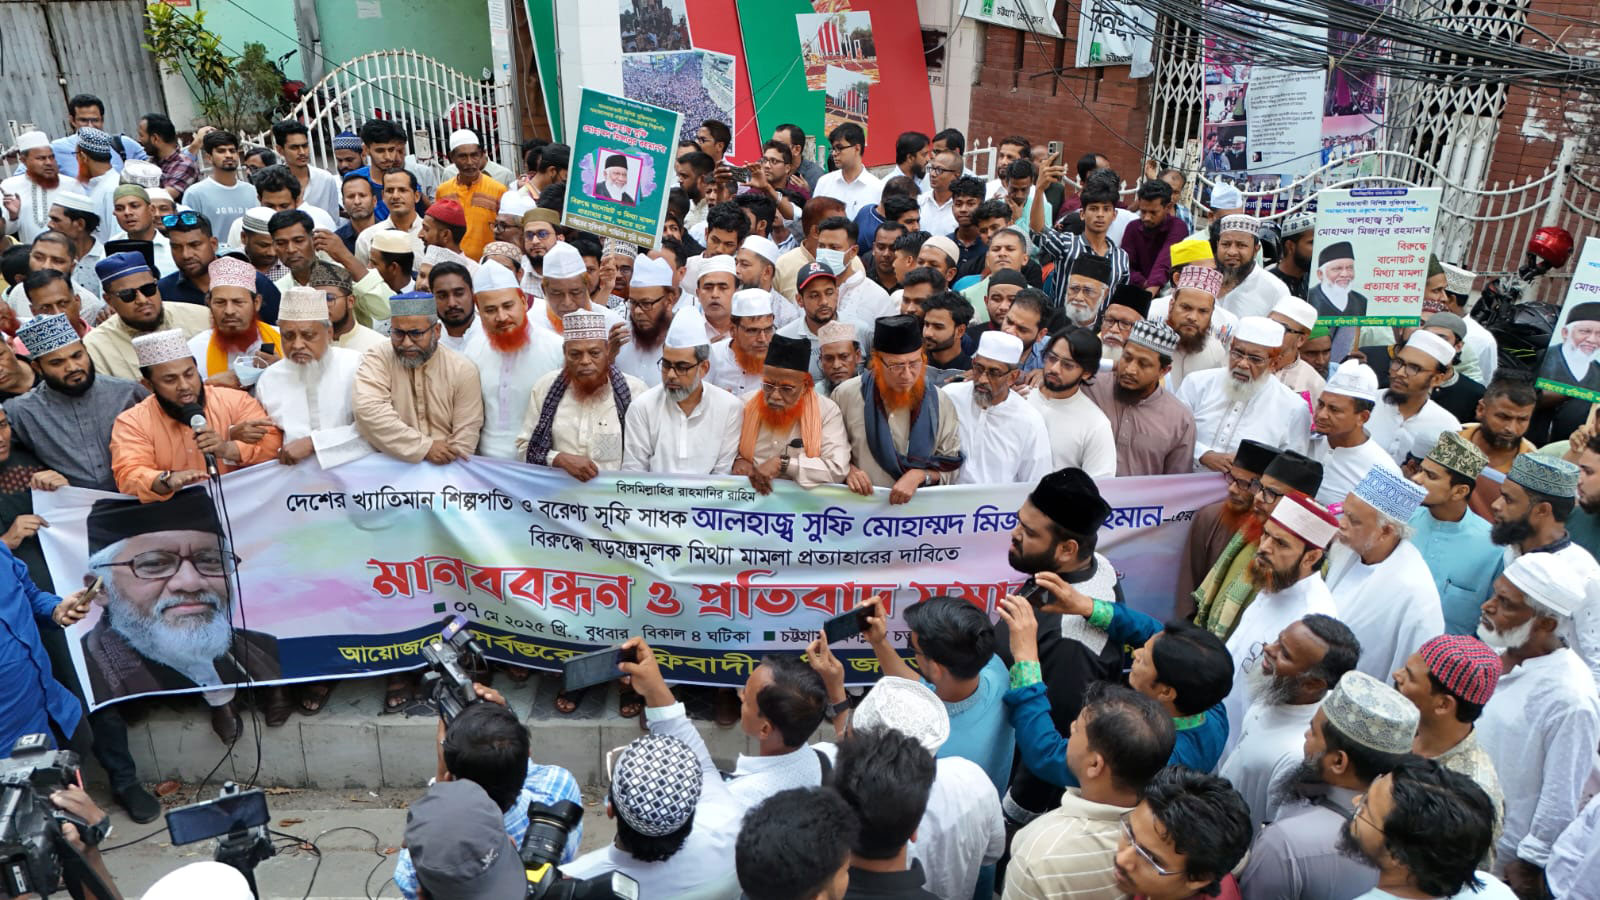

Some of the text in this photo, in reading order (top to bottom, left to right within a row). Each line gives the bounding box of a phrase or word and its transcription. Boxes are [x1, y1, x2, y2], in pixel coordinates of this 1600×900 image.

[1318, 228, 1354, 236] মোহাম্মদ
[1357, 226, 1390, 237] মিজানুর
[1397, 240, 1428, 251] বিরুদ্ধে
[1373, 267, 1425, 277] মিথ্যা মামলা
[616, 480, 756, 503] বিসমিল্লাহির রাহমানির রাহিম
[286, 490, 347, 512] দেশের
[352, 485, 435, 512] খ্যাতিমান
[440, 484, 513, 512] শিল্পপতি
[520, 499, 533, 514] ও
[538, 500, 589, 523] বরেণ্য
[594, 501, 633, 531] সূফি
[638, 508, 688, 528] সাধক
[691, 506, 795, 543] আলহাজ্ব
[802, 506, 855, 544] সুফি
[863, 513, 966, 538] মোহাম্মদ
[528, 524, 962, 568] বিরুদ্ধে ষড়যন্ত্রমূলক মিথ্যা মামলা প্রত্যাহারের দাবিতে
[366, 555, 635, 618] মানববন্ধন
[646, 580, 684, 617] ও
[692, 568, 901, 620] প্রতিবাদ
[454, 601, 480, 619] ০৭
[484, 610, 499, 624] মে
[505, 614, 545, 634] ২০২৫
[584, 625, 630, 642] বুধবার
[641, 624, 687, 642] বিকাল
[692, 630, 701, 642] ৪
[707, 627, 752, 644] ঘটিকা
[468, 629, 588, 663] সর্বস্তরে
[655, 648, 761, 676] ফিবাদী
